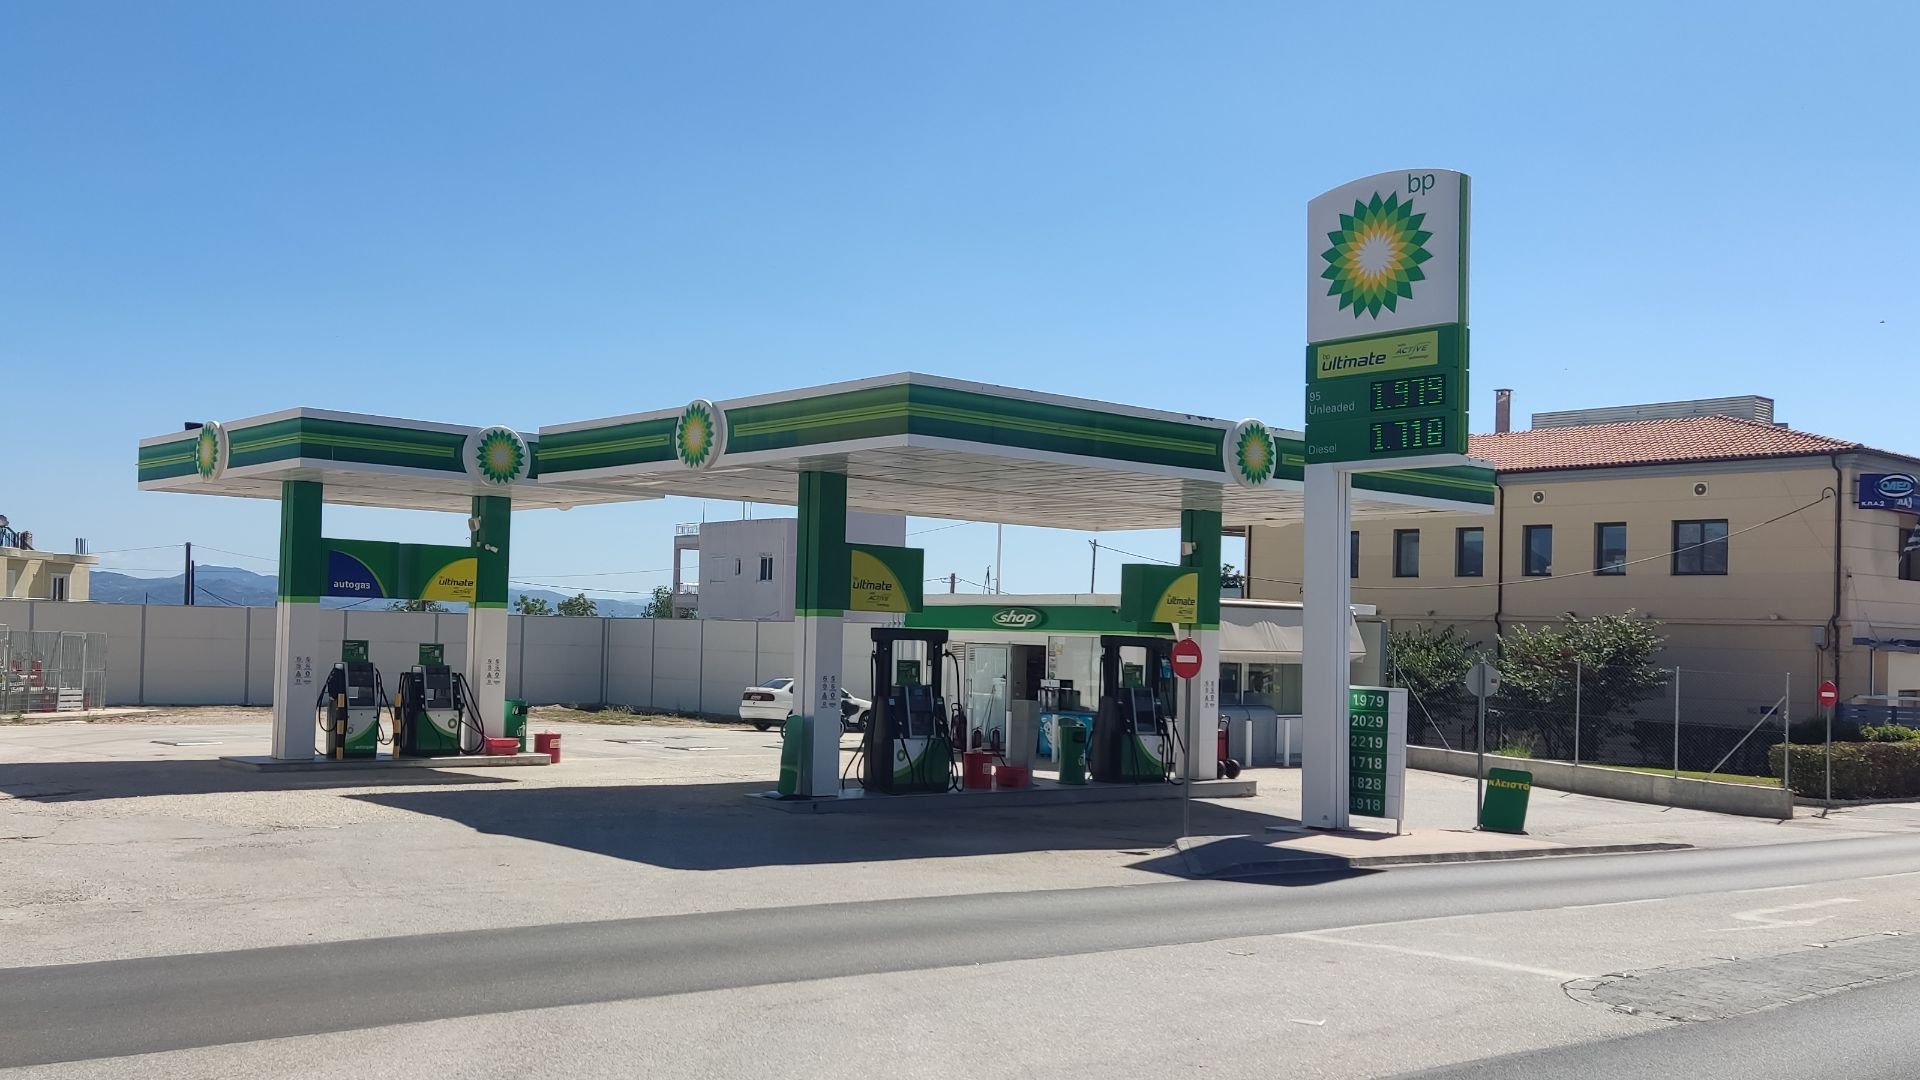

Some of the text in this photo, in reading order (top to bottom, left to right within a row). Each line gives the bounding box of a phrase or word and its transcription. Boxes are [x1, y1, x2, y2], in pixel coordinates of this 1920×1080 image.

[1408, 173, 1435, 196] bp
[1396, 344, 1429, 354] ACTIVE
[1321, 351, 1387, 372] ultimate
[1309, 391, 1321, 402] 95
[1372, 376, 1443, 410] 1.979
[1309, 402, 1355, 415] Unleaded
[1372, 418, 1443, 450] 1.718
[1308, 443, 1337, 455] Diesel
[333, 580, 371, 591] autogas
[438, 577, 474, 587] ultimate
[852, 579, 893, 591] ultimate
[999, 609, 1037, 627] shop
[1352, 694, 1385, 708] 1979
[1351, 715, 1384, 728] 2029
[1350, 735, 1384, 749] 2219
[1351, 756, 1383, 770] 1718
